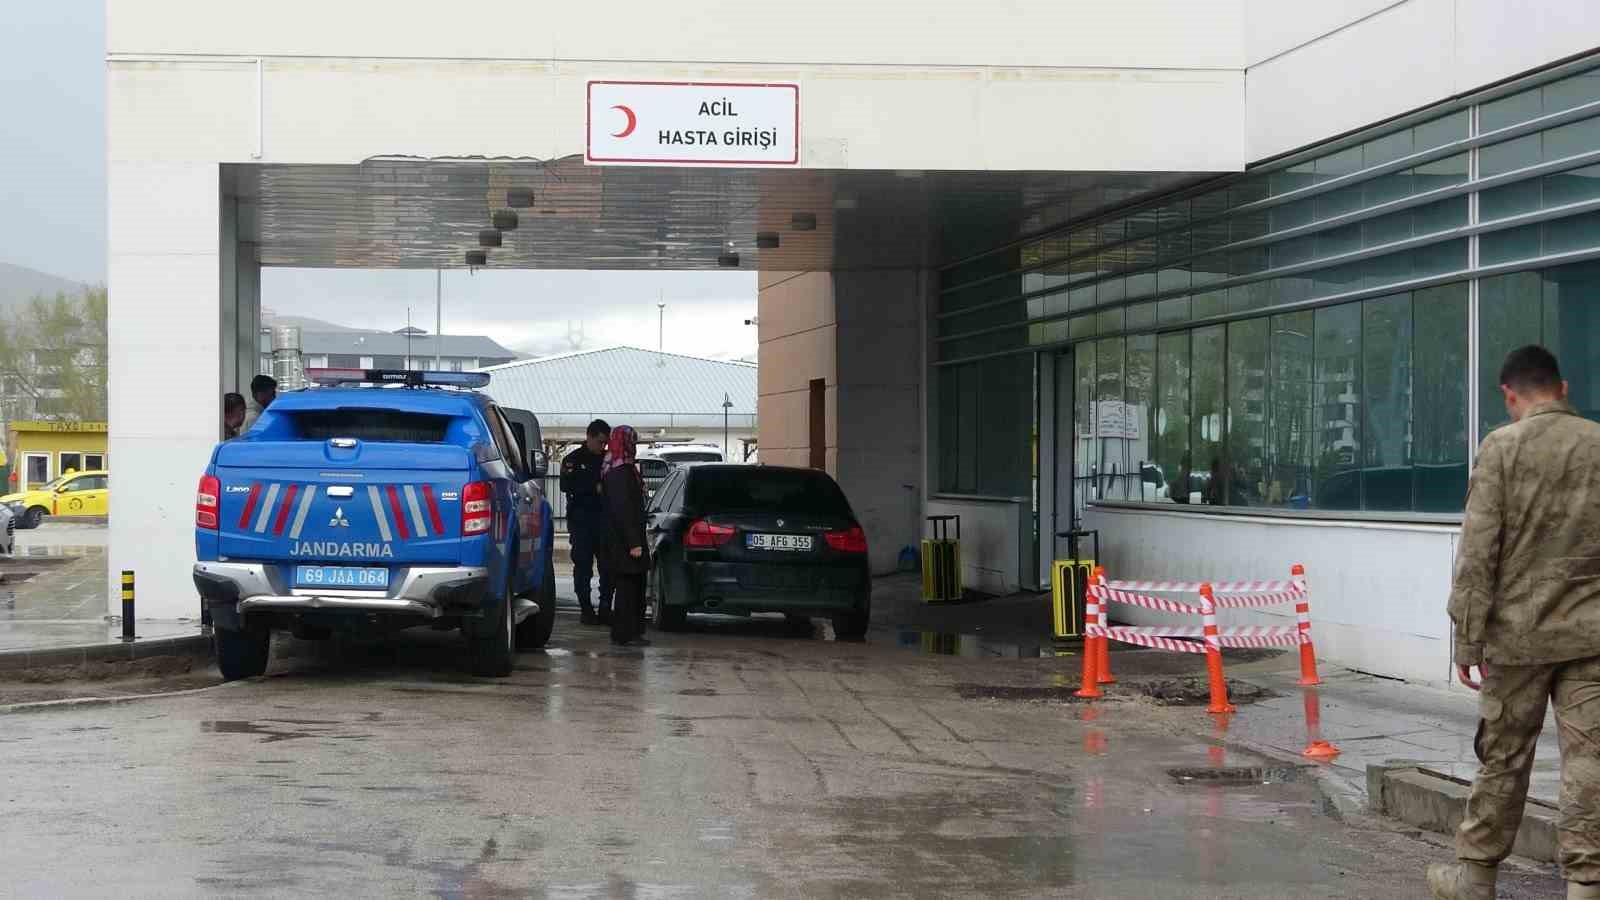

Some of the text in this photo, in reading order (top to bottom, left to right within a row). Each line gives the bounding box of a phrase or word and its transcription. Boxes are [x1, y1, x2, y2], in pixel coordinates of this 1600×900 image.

[698, 97, 738, 116] ACİL
[658, 127, 777, 150] HASTA GİRİŞİ
[289, 541, 393, 557] JANDARMA
[753, 535, 810, 548] 05 AFG 355
[304, 568, 385, 585] 69 JAA 064
